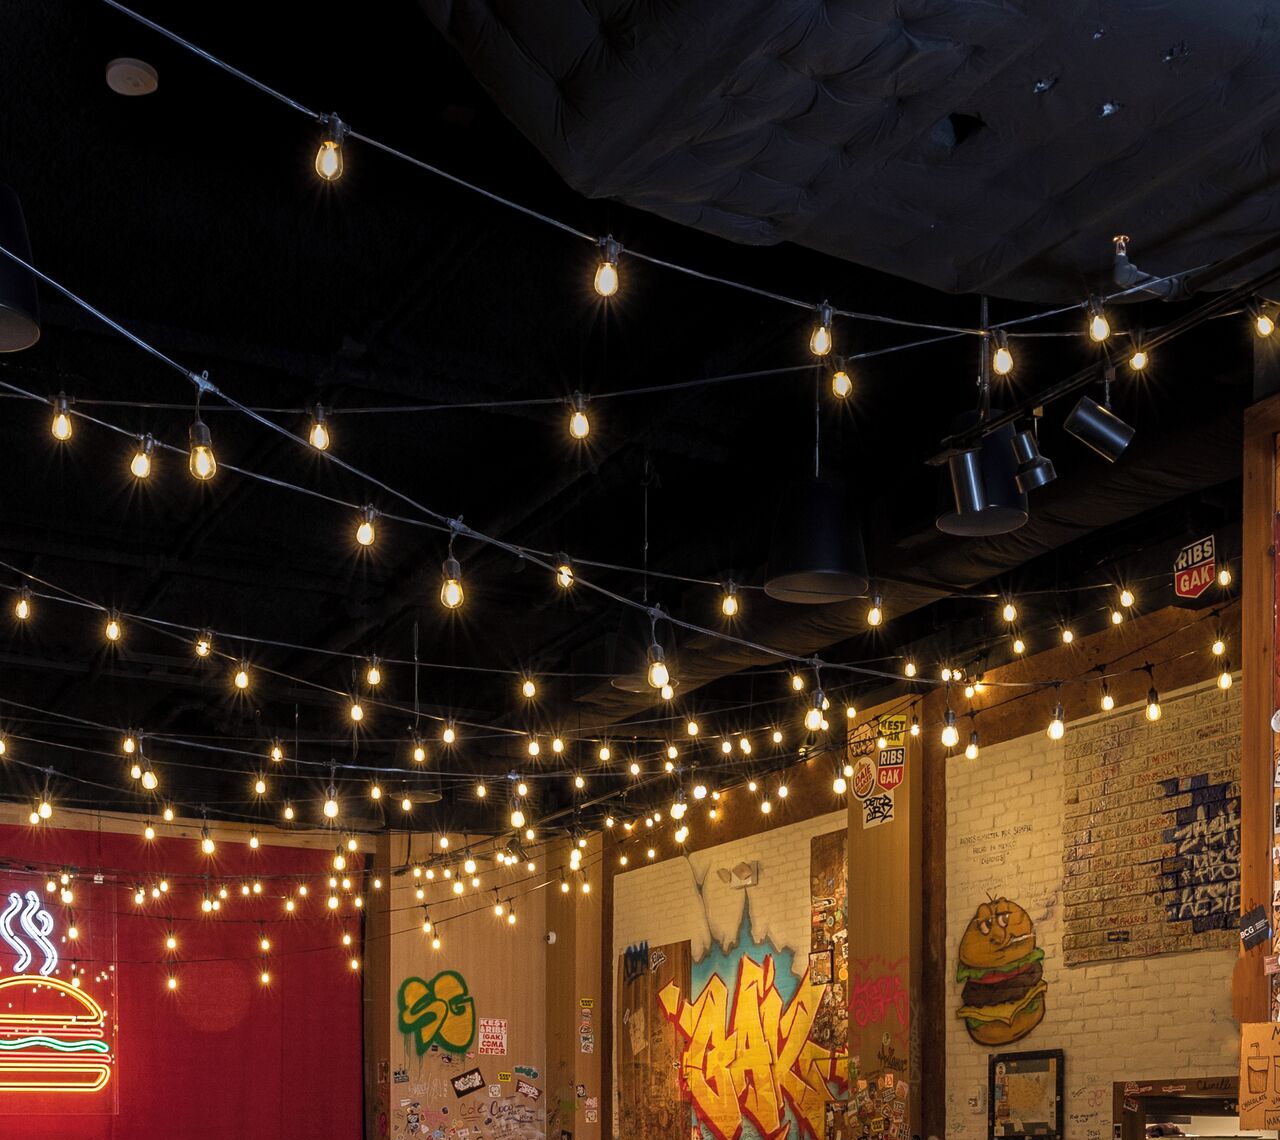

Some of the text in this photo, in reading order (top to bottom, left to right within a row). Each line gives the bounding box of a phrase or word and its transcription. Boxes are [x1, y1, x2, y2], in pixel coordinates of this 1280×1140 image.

[1178, 541, 1212, 569] RIBS
[1180, 566, 1211, 592] GAK
[880, 750, 903, 764] RIBS
[880, 769, 899, 784] GAK
[480, 1019, 506, 1027] KEST
[480, 1047, 505, 1055] DETOR
[481, 1040, 504, 1048] COMA
